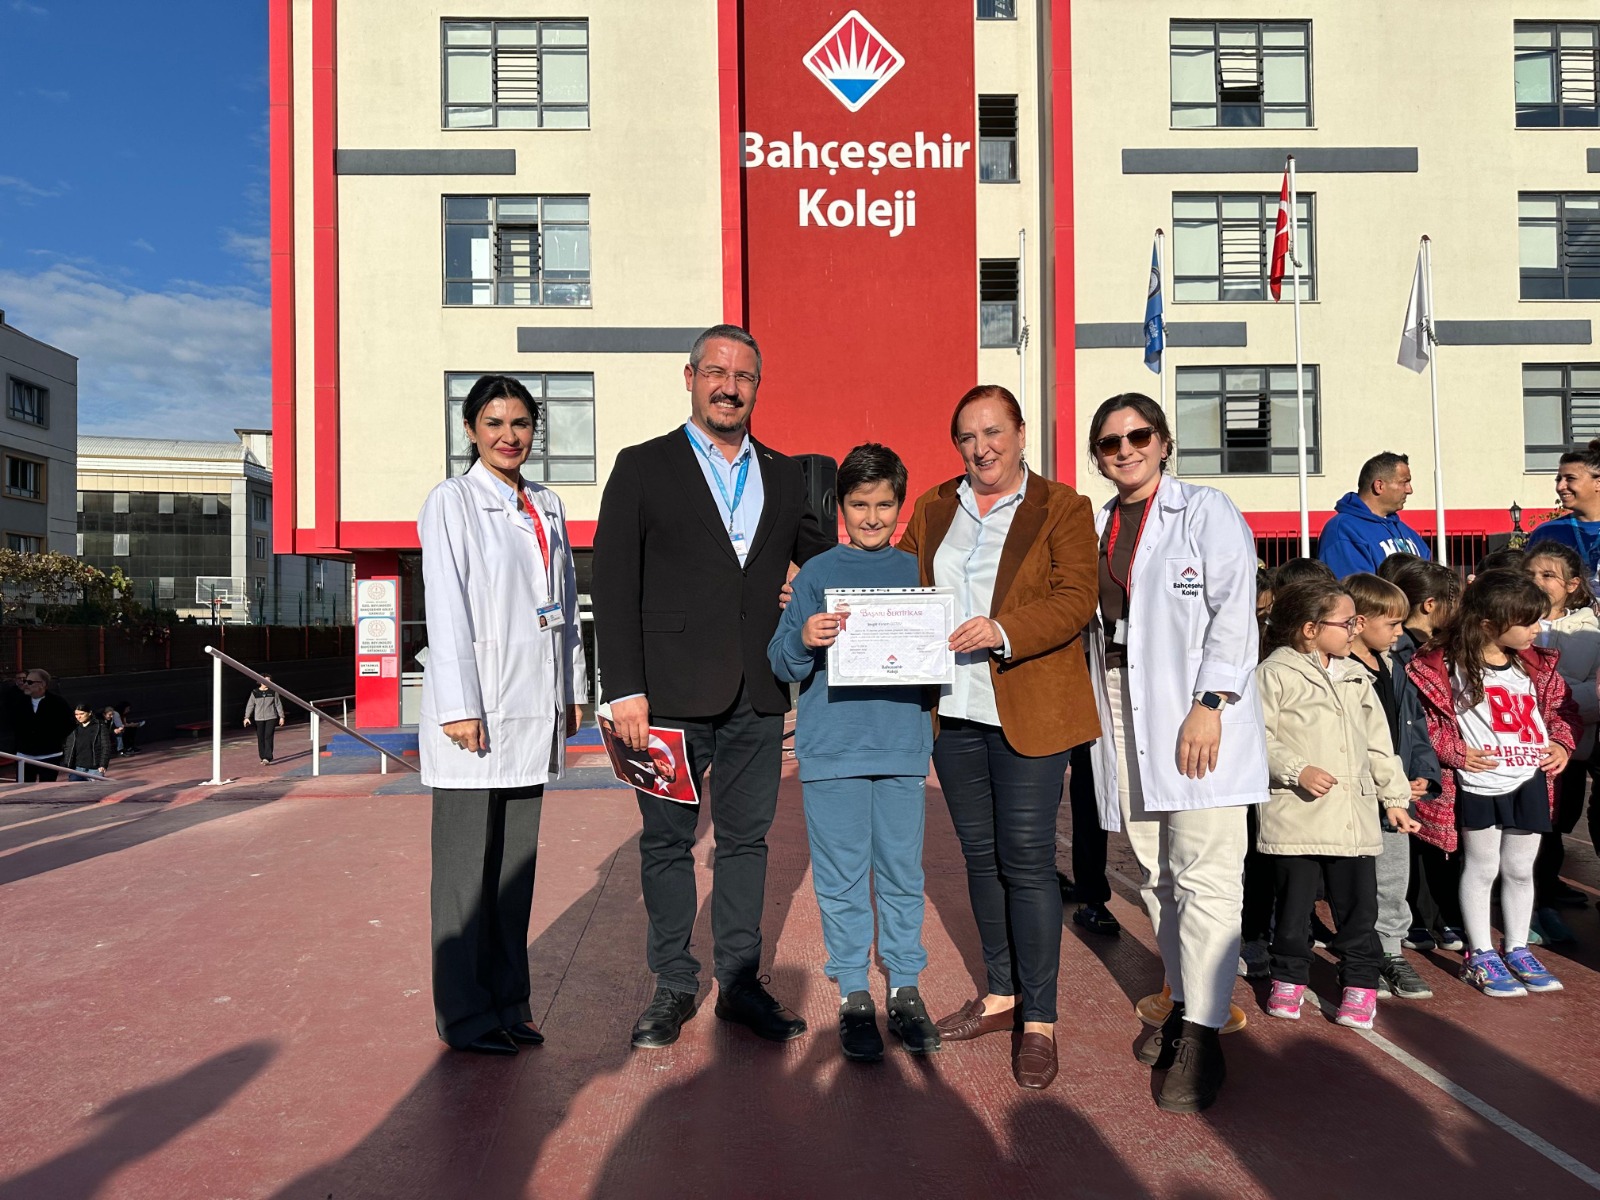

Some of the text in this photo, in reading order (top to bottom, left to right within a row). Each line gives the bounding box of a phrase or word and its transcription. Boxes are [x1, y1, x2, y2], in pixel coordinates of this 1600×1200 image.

[739, 131, 971, 176] Bahçeşehir
[799, 188, 916, 238] Koleji
[1484, 684, 1545, 745] BK
